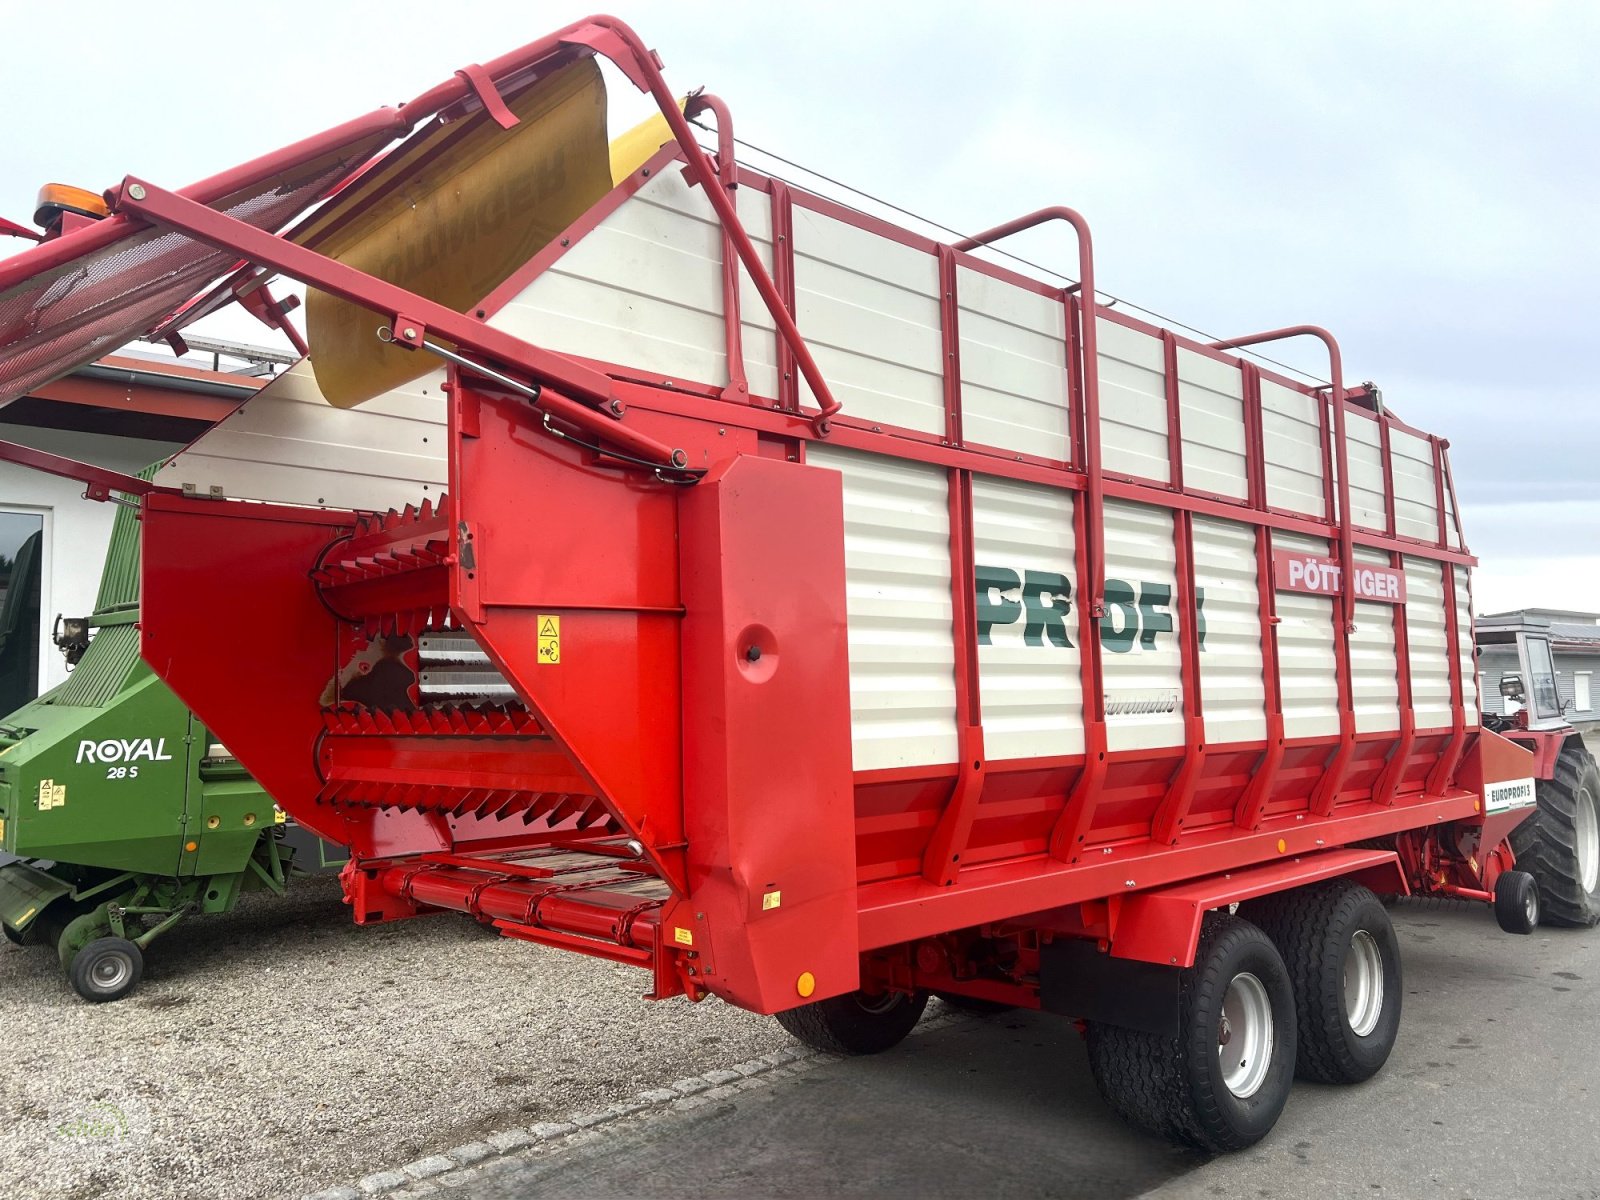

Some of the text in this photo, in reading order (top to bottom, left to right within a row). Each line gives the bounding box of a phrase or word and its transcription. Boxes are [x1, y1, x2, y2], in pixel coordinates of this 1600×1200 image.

[1289, 558, 1399, 598] PÖTTNGER
[75, 738, 172, 764] ROYAL
[106, 766, 138, 779] 28 S
